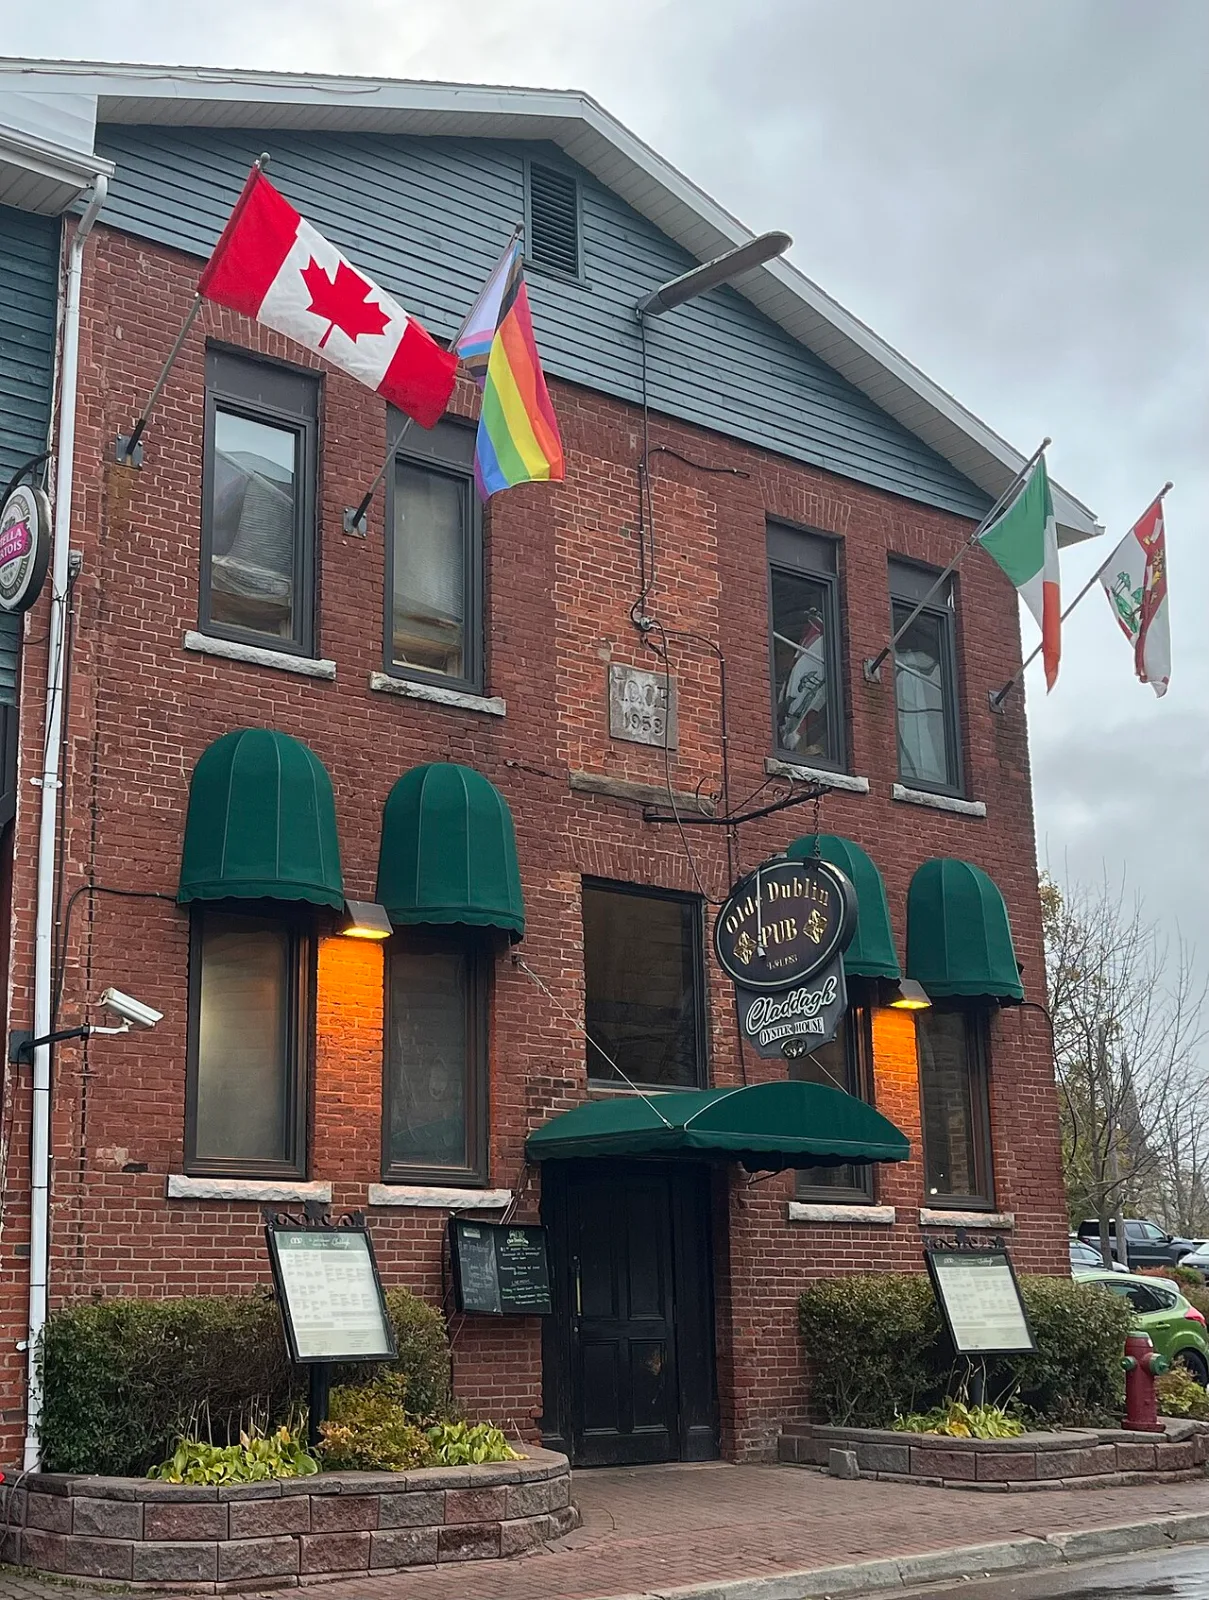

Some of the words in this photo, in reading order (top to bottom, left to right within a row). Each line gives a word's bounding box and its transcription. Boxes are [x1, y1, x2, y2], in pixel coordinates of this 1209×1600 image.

[726, 896, 763, 934] Olde
[767, 877, 828, 907] Dublin
[761, 918, 798, 948] PUB
[745, 975, 838, 1035] Claddagh
[795, 1017, 824, 1034] HOUSE
